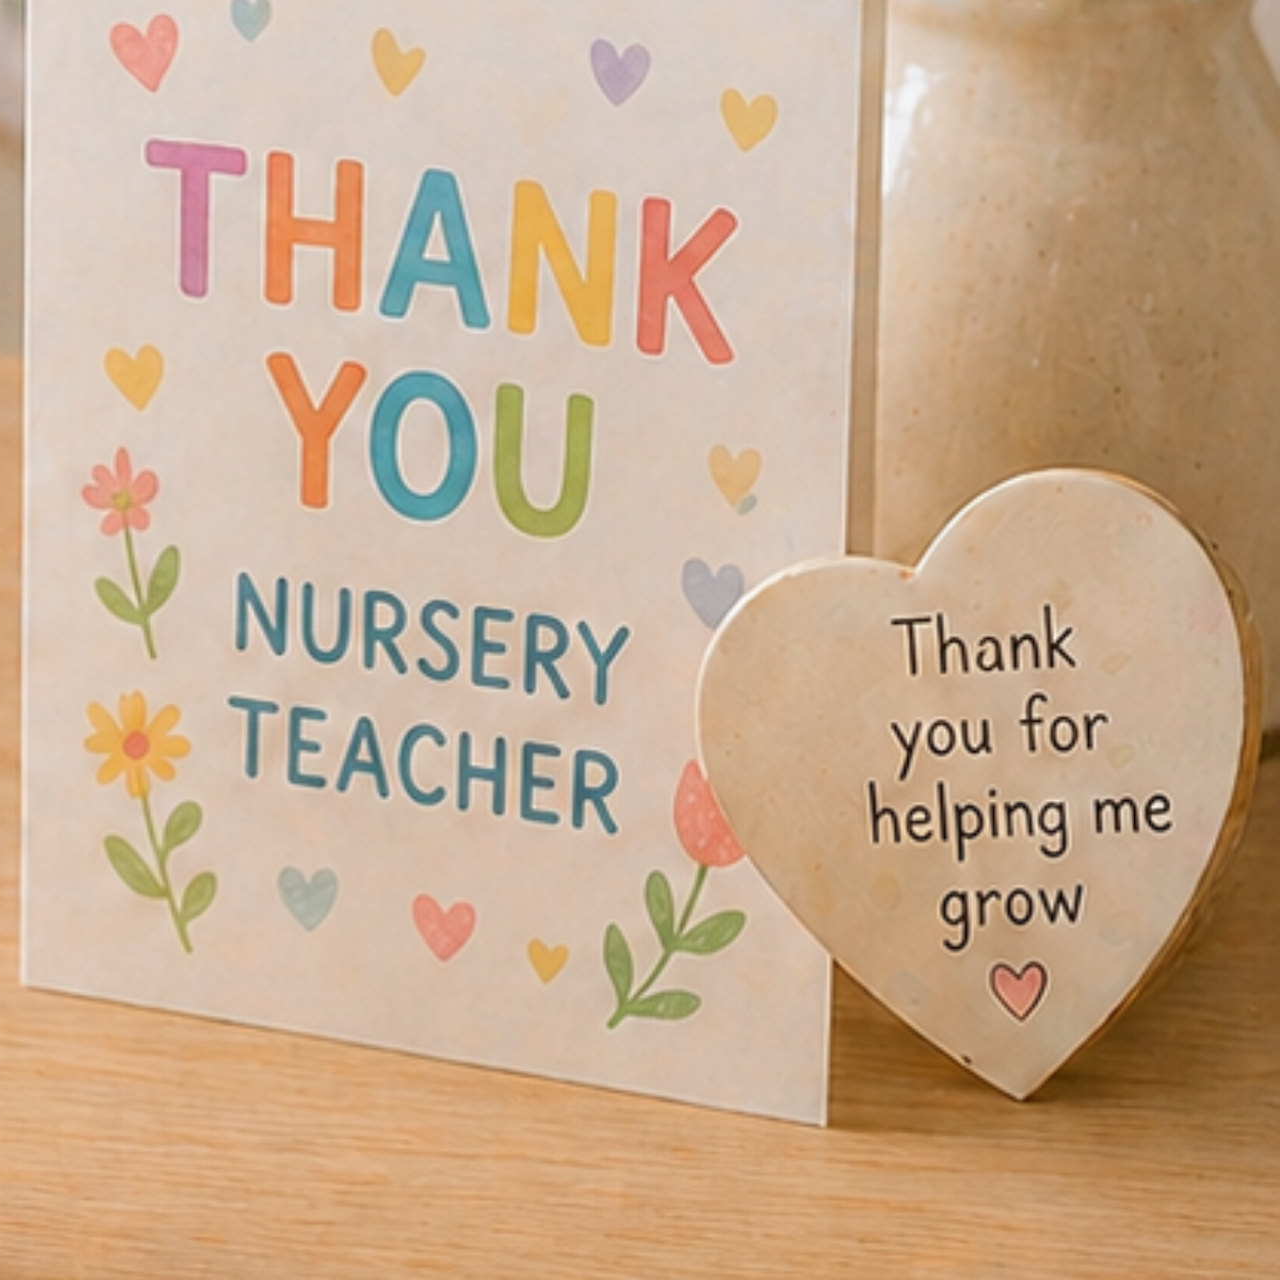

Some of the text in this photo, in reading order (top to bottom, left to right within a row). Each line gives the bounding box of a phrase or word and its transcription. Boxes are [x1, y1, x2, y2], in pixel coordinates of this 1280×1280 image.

[142, 135, 740, 368] THANK
[264, 349, 598, 542] YOU
[233, 572, 632, 708] NURSERY
[889, 604, 1078, 677] Thank
[226, 694, 621, 836] TEACHER
[889, 691, 1110, 786] you for
[867, 780, 1174, 864] helping me
[939, 883, 1085, 953] grow
